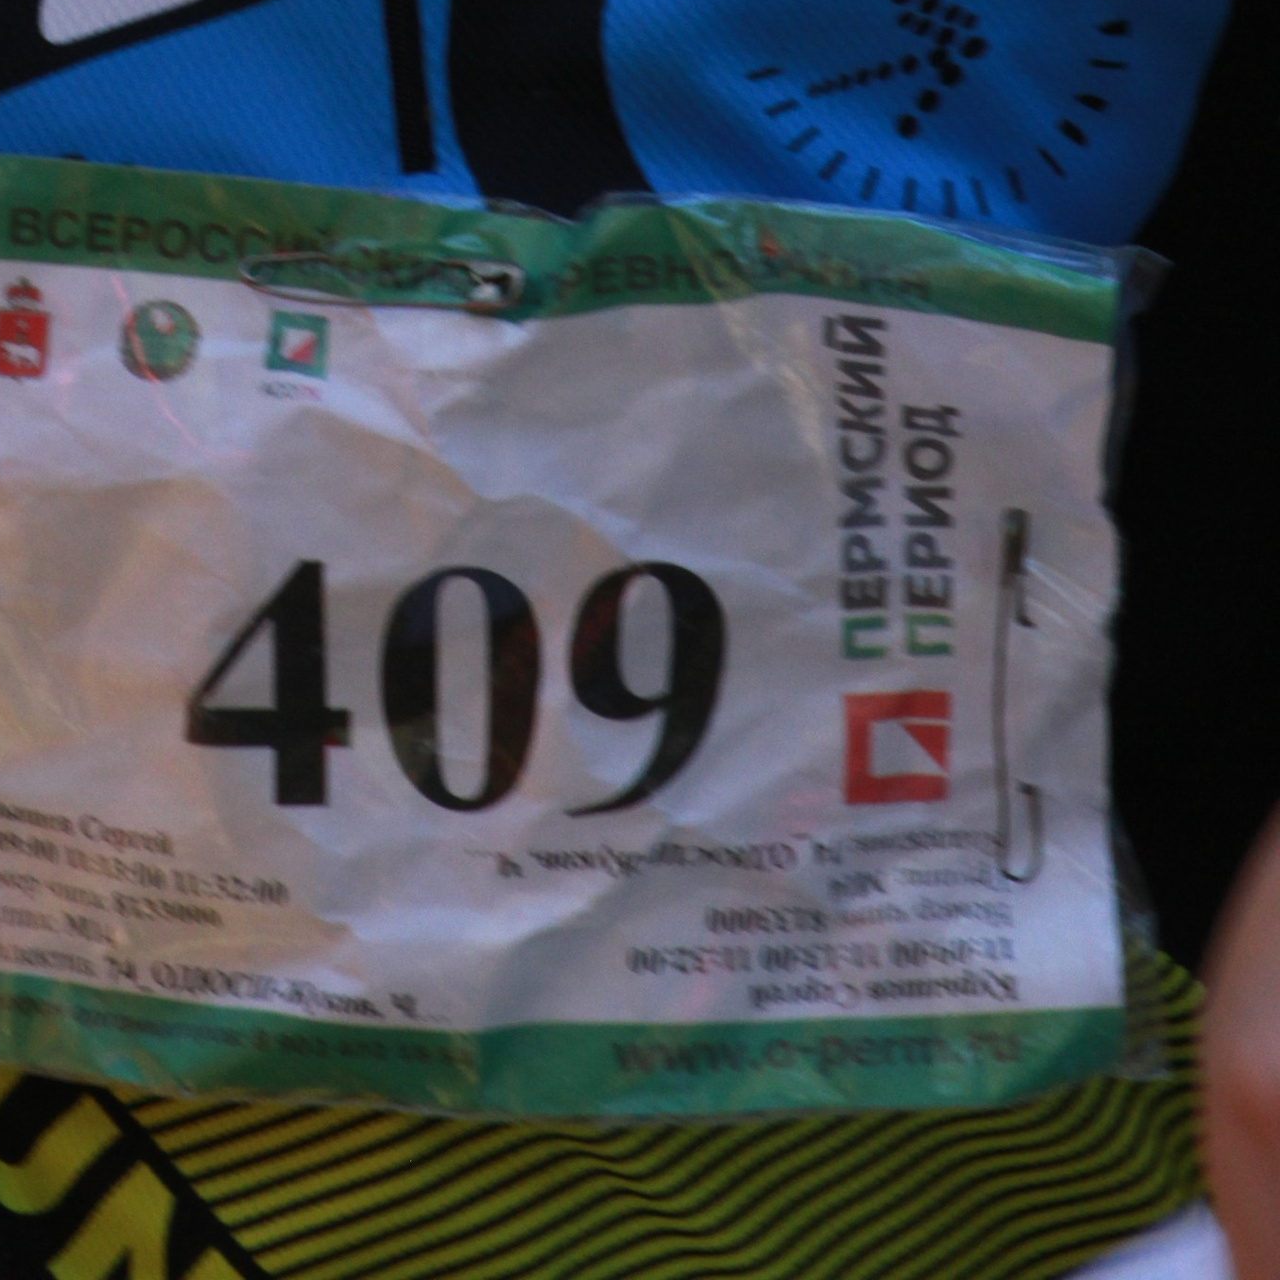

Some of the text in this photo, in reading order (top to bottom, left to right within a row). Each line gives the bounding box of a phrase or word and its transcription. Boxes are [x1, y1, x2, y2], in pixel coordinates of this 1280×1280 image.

[824, 314, 889, 659] ПЕРМСКИЙ
[898, 403, 962, 659] ПЕРИОД
[185, 556, 726, 816] 409
